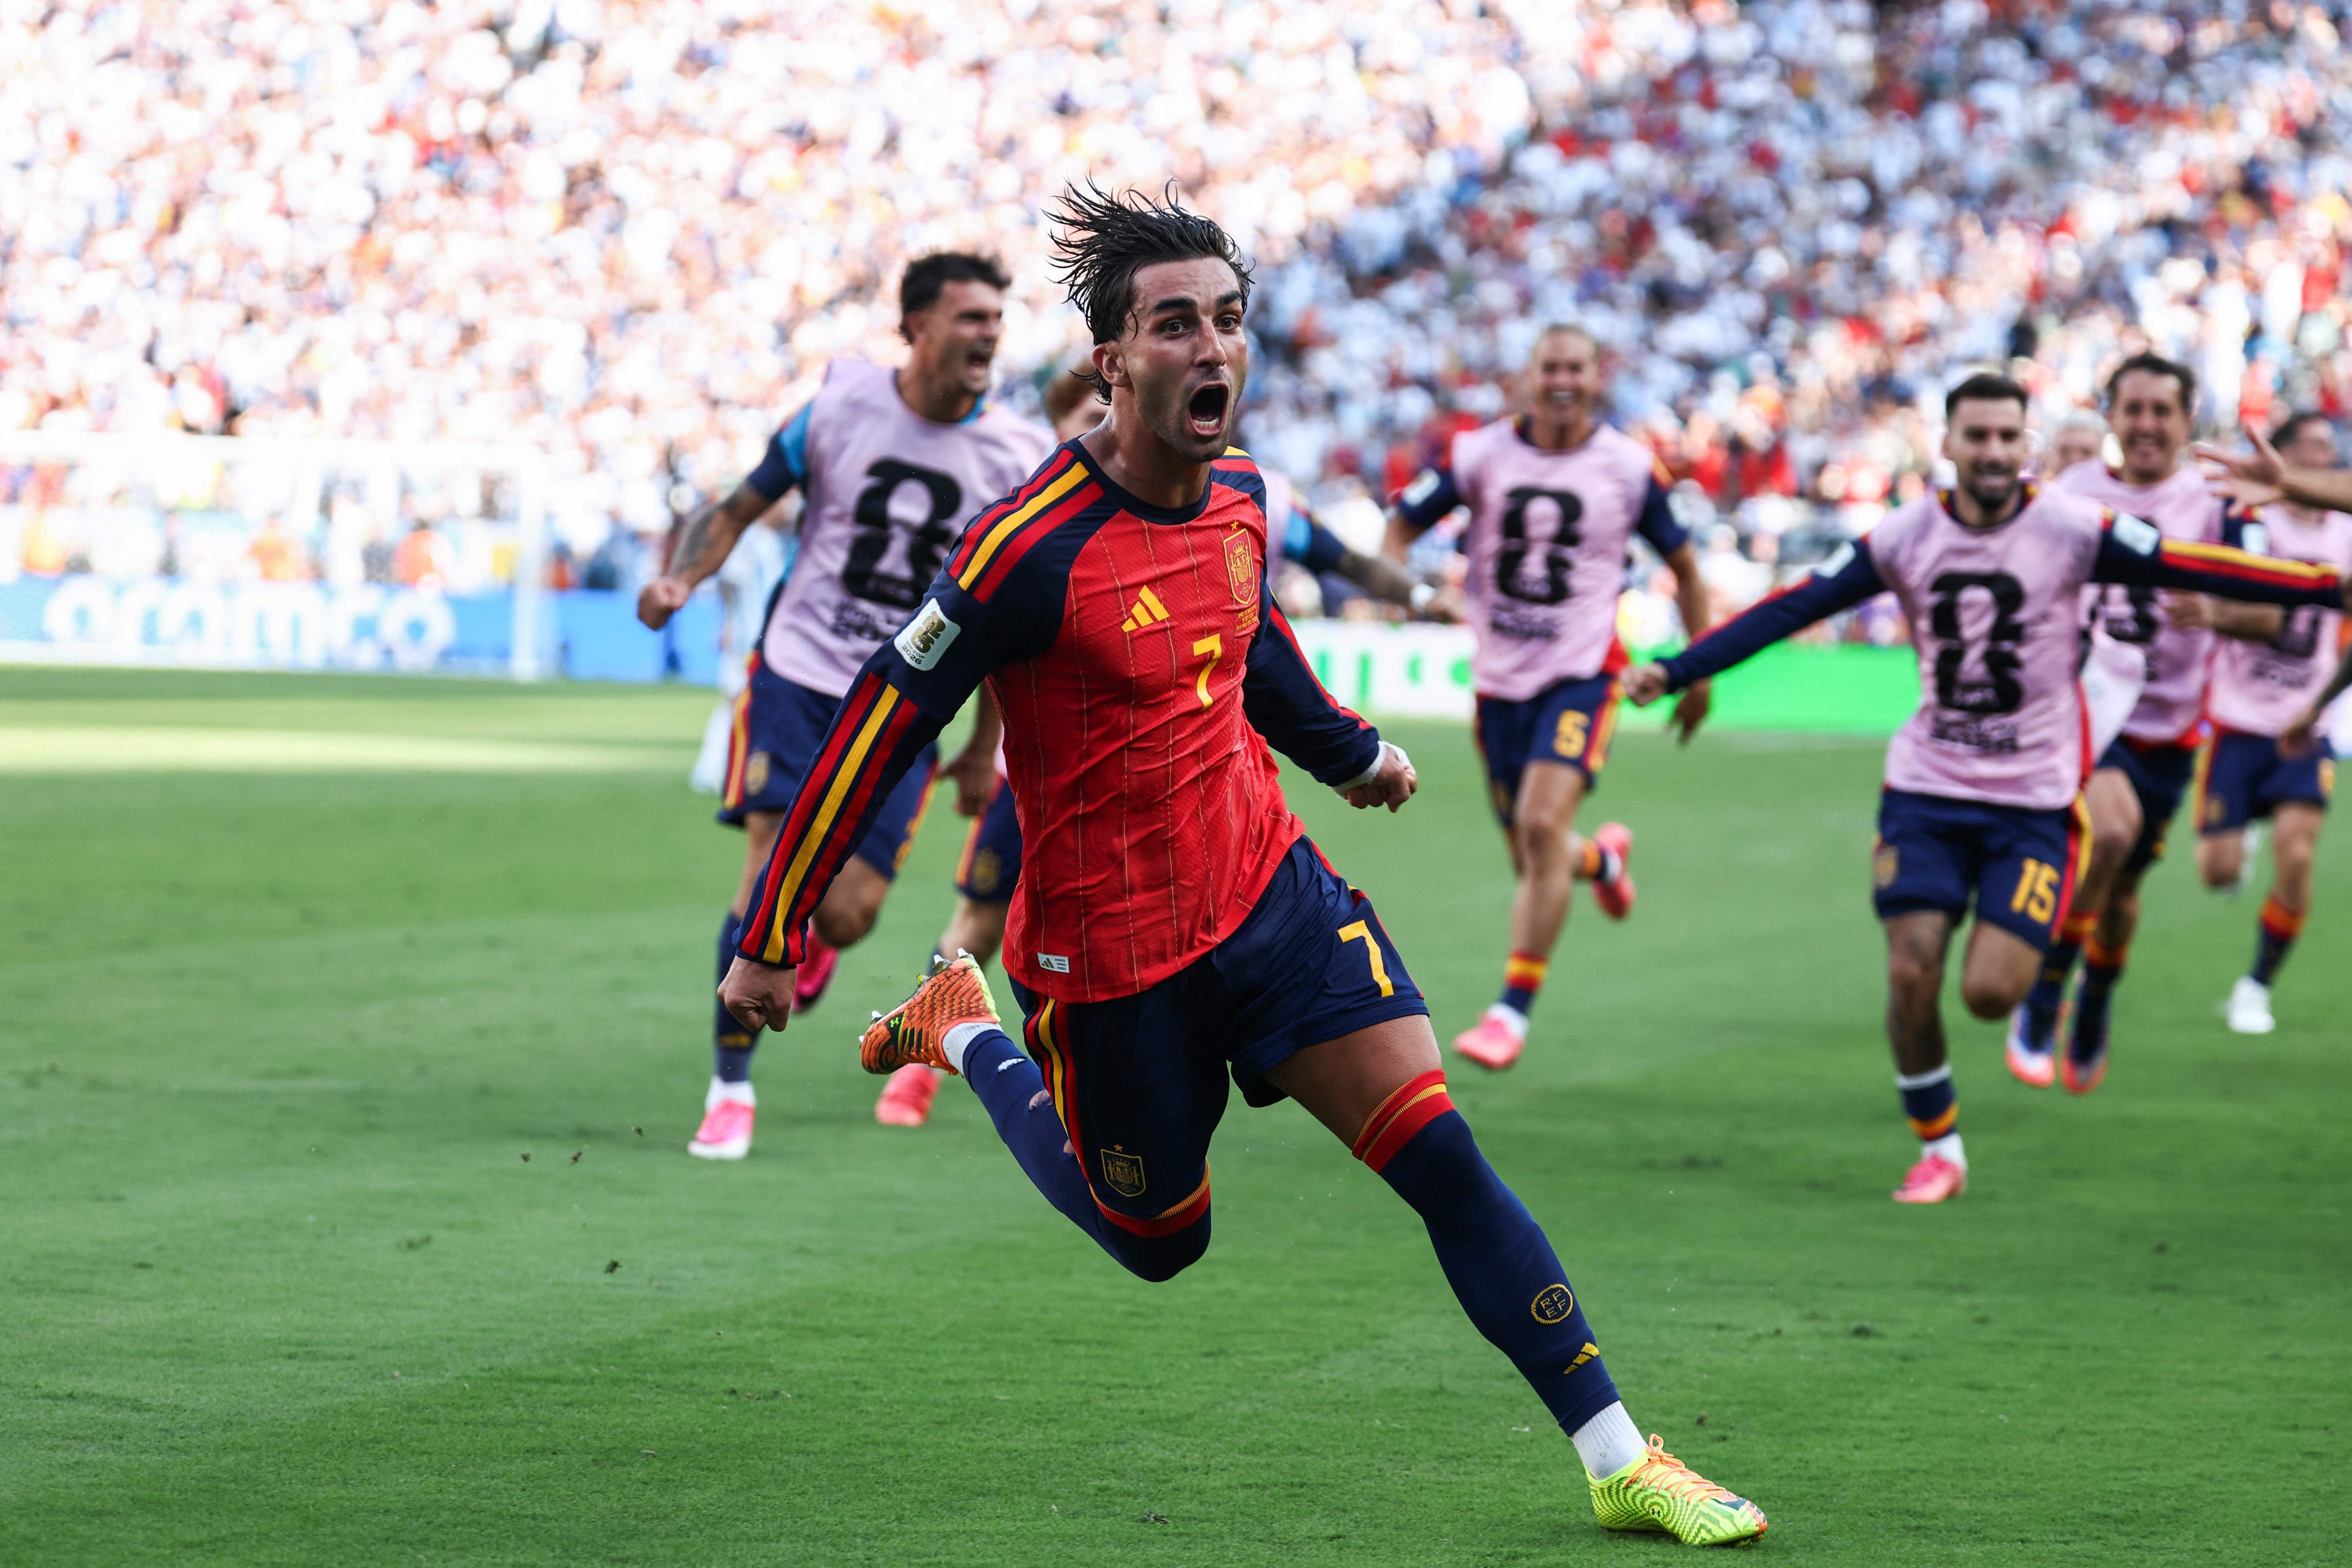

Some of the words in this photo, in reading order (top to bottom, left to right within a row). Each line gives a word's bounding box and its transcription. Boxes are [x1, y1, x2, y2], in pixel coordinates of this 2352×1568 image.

[902, 644, 922, 664] 2026
[906, 641, 916, 654] WORLD
[914, 638, 923, 649] FIFA
[1193, 633, 1222, 710] 7
[1553, 710, 1589, 758] 5
[2010, 858, 2060, 924] 15
[1337, 920, 1395, 998] 7
